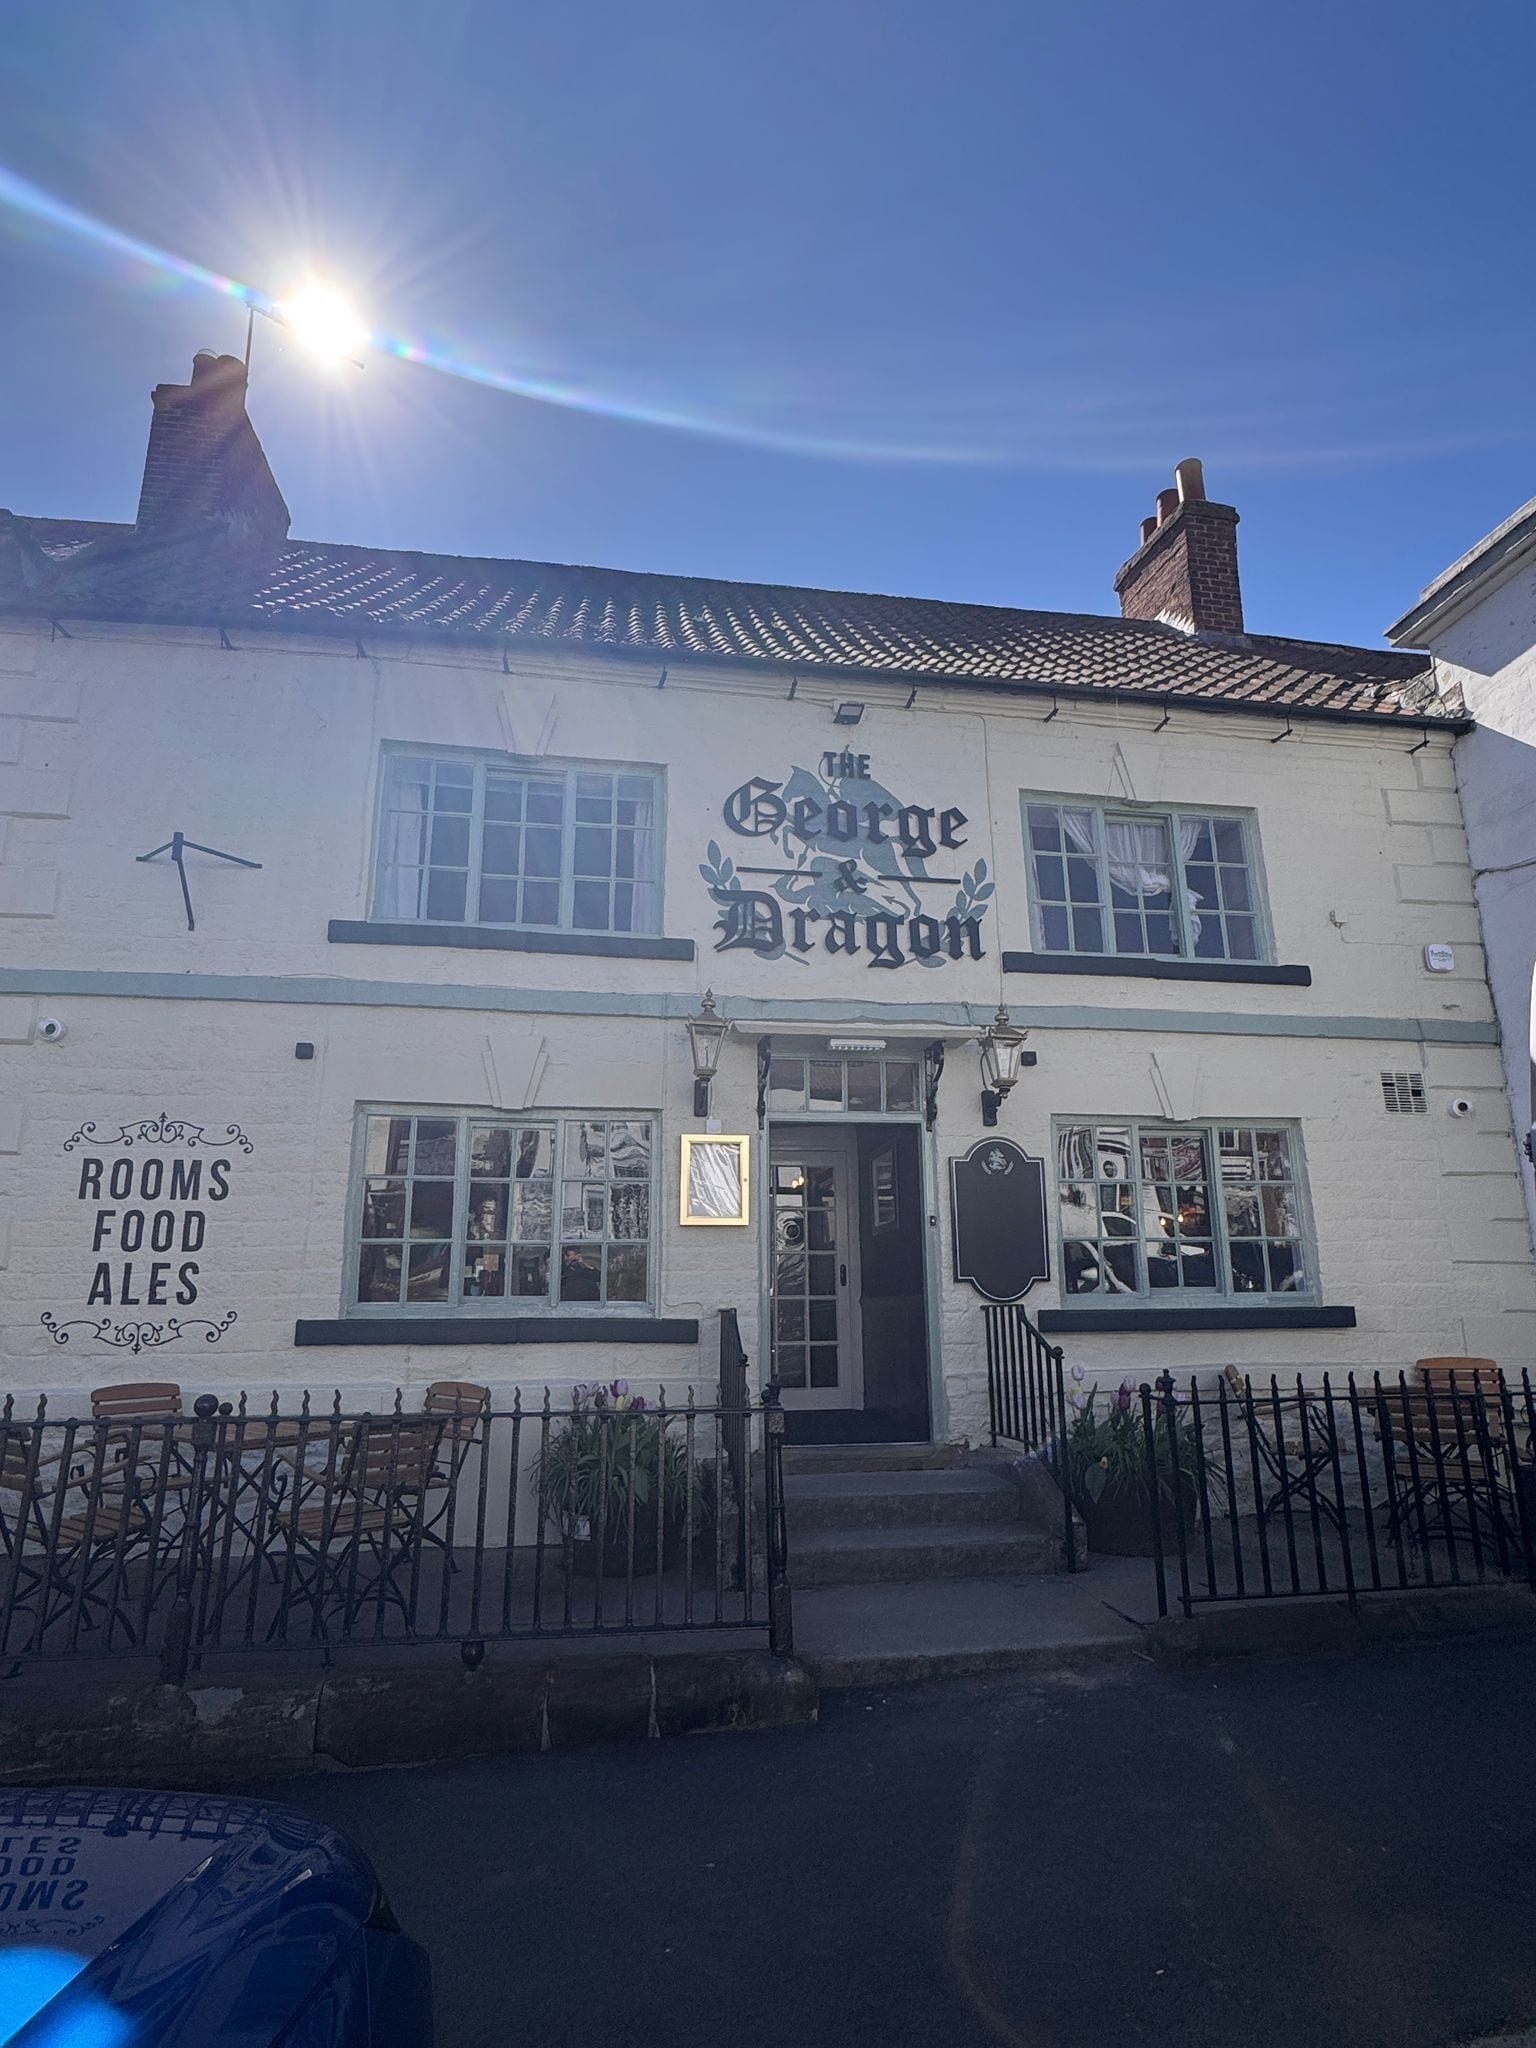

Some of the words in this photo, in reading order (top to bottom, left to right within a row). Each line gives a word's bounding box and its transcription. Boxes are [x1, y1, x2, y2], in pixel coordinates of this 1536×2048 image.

[823, 751, 871, 779] THE
[723, 776, 969, 858] George
[833, 858, 868, 894] &
[712, 885, 987, 969] Dragon
[78, 1158, 232, 1201] ROOMS
[92, 1209, 206, 1252] FOOD
[87, 1261, 200, 1306] ALES
